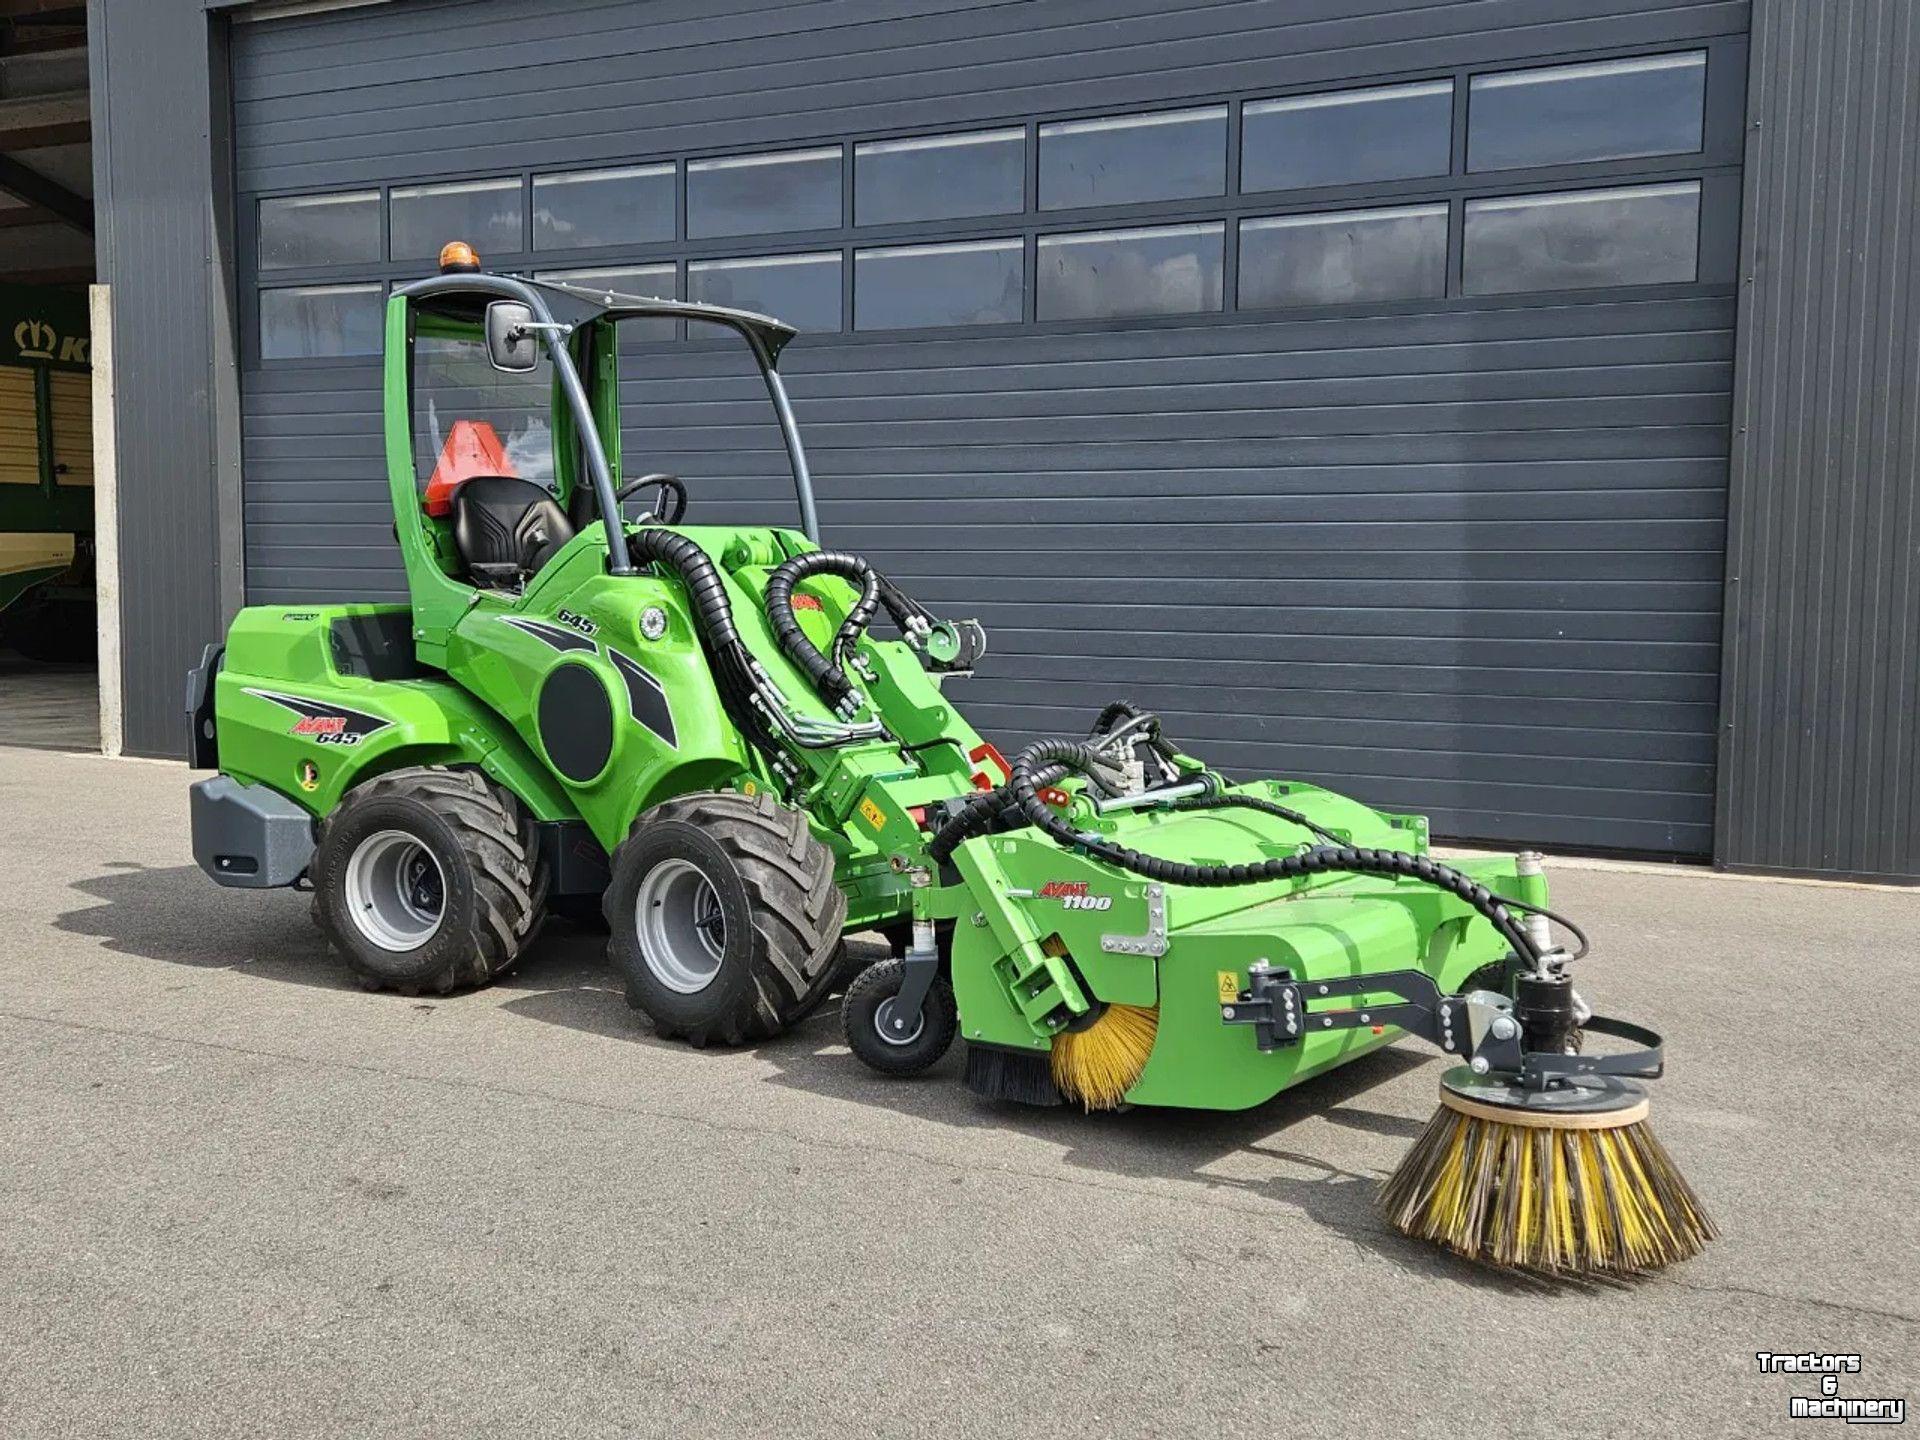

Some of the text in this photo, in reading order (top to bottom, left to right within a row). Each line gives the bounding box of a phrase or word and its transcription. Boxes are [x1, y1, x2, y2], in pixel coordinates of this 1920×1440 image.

[60, 336, 91, 362] K
[1039, 881, 1089, 898] AVANT
[1062, 895, 1112, 911] 1100
